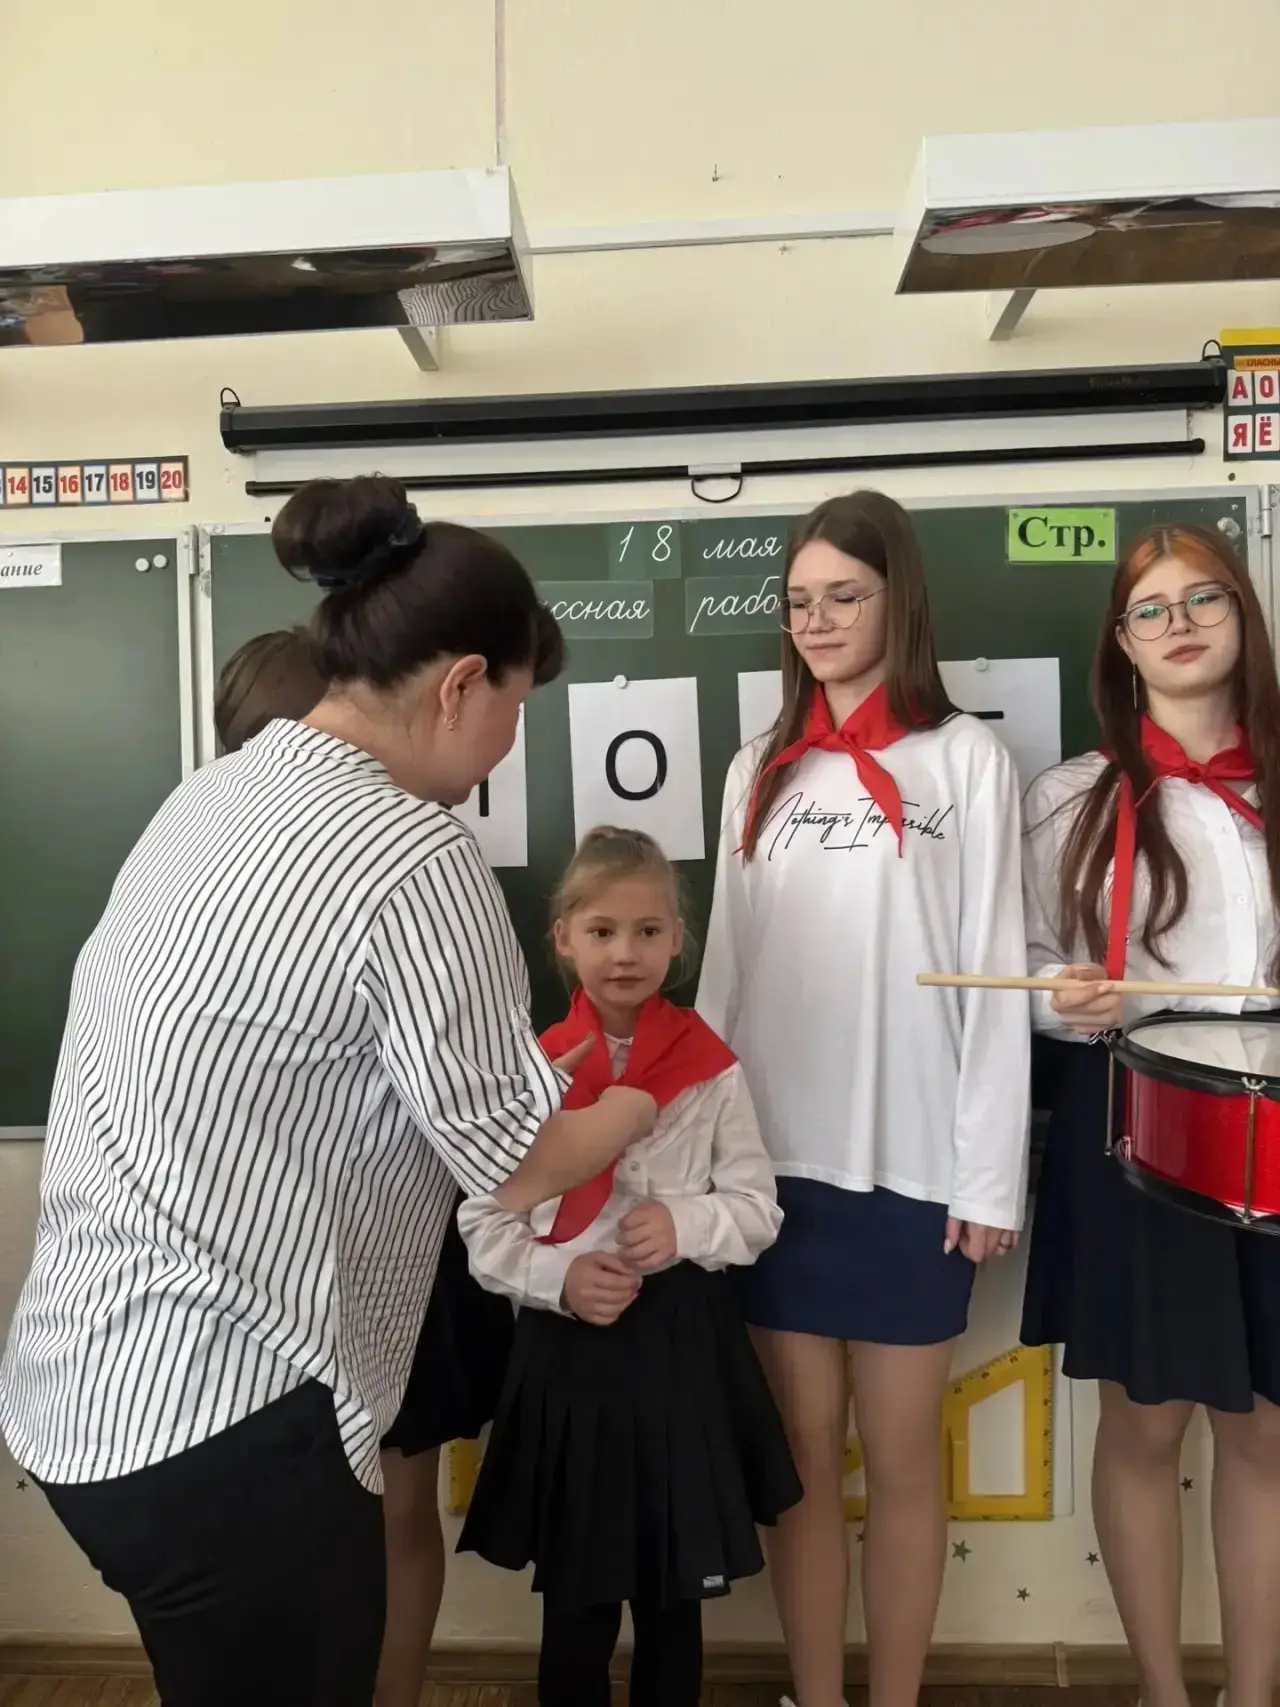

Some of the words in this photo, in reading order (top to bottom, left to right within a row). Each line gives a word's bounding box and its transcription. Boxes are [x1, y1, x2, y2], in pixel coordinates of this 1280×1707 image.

[1232, 376, 1248, 399] А
[1260, 375, 1274, 398] О
[1232, 423, 1248, 447] Я
[1259, 416, 1272, 446] Ё
[8, 476, 28, 494] 14
[34, 476, 53, 493] 15
[60, 475, 78, 493] 16
[86, 473, 104, 492] 17
[111, 472, 130, 491] 18
[136, 471, 155, 489] 19
[161, 470, 182, 489] 20
[703, 536, 782, 559] мая
[1018, 516, 1106, 556] Стр.
[1, 563, 43, 577] ание
[545, 599, 650, 620] ссная
[690, 576, 780, 632] рабо
[824, 797, 954, 852] Impssible
